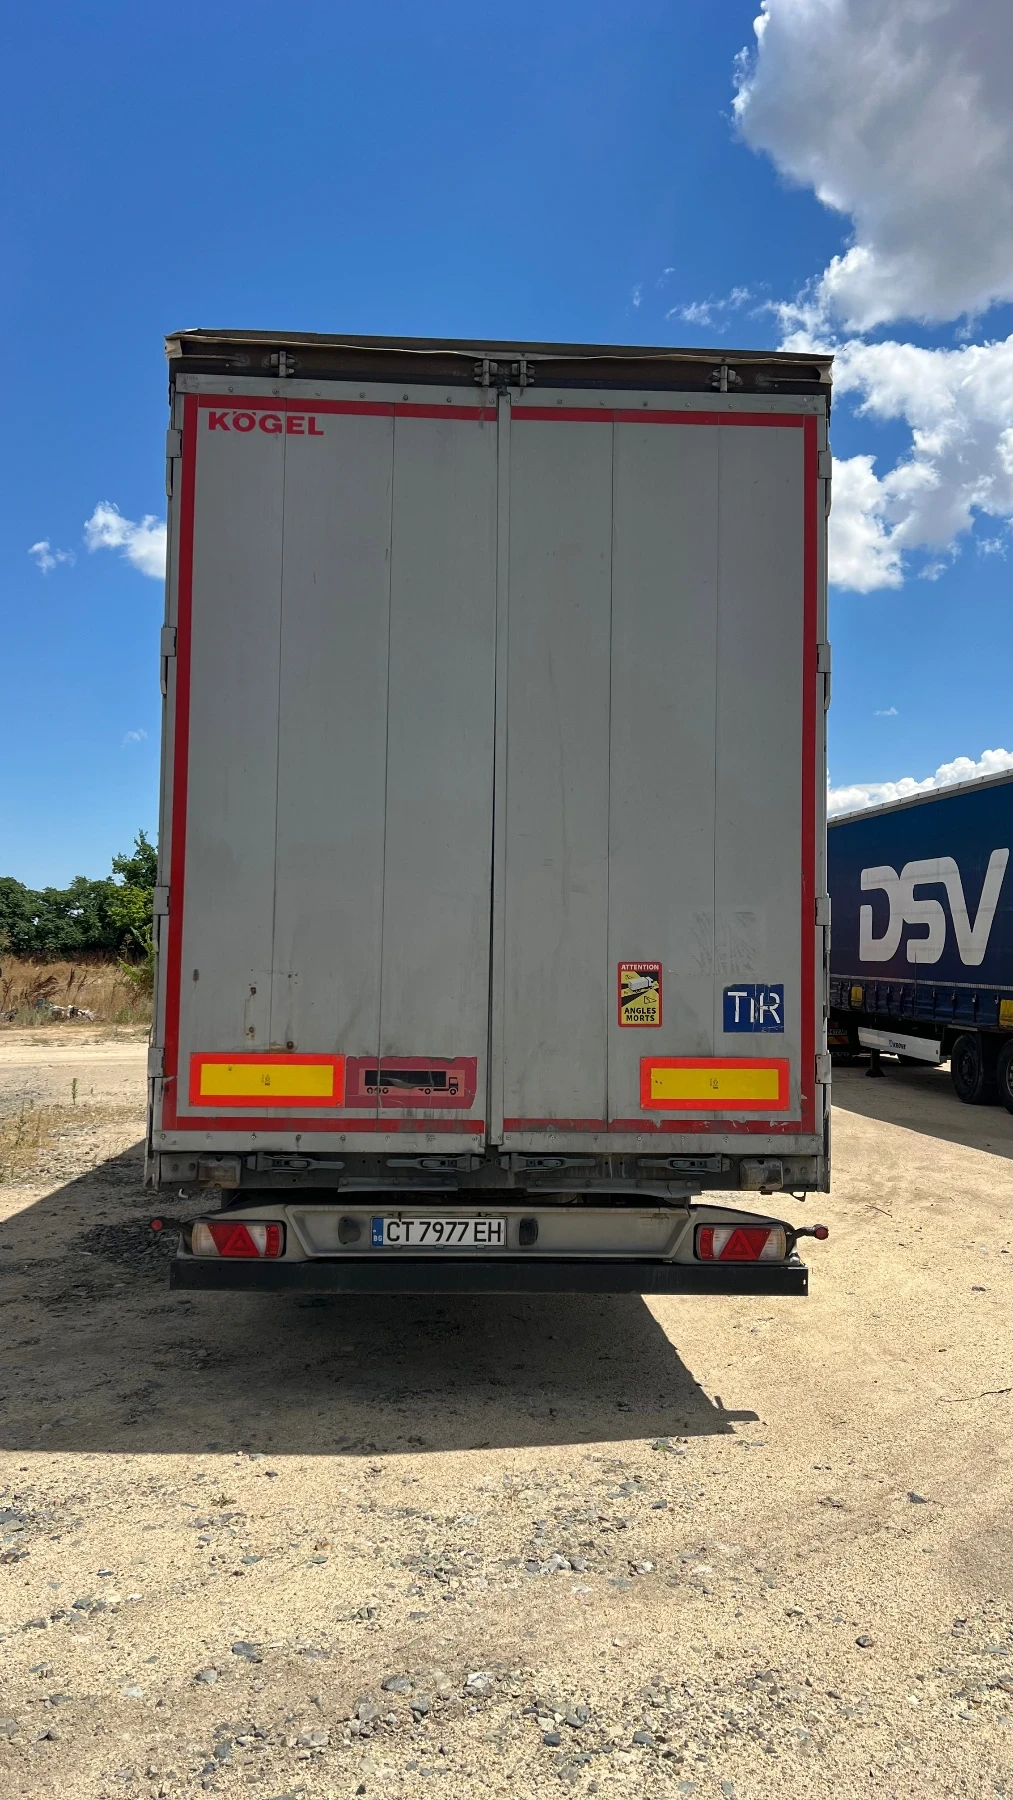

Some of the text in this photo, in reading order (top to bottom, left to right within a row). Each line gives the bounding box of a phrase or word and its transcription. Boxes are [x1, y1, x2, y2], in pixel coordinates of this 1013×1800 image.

[208, 411, 324, 436] KÖGEL
[859, 848, 1010, 966] DSV
[624, 1007, 657, 1015] ANGLES
[626, 1014, 655, 1022] MORTS
[727, 991, 781, 1024] TIR
[386, 1221, 501, 1243] CT 7977 EH
